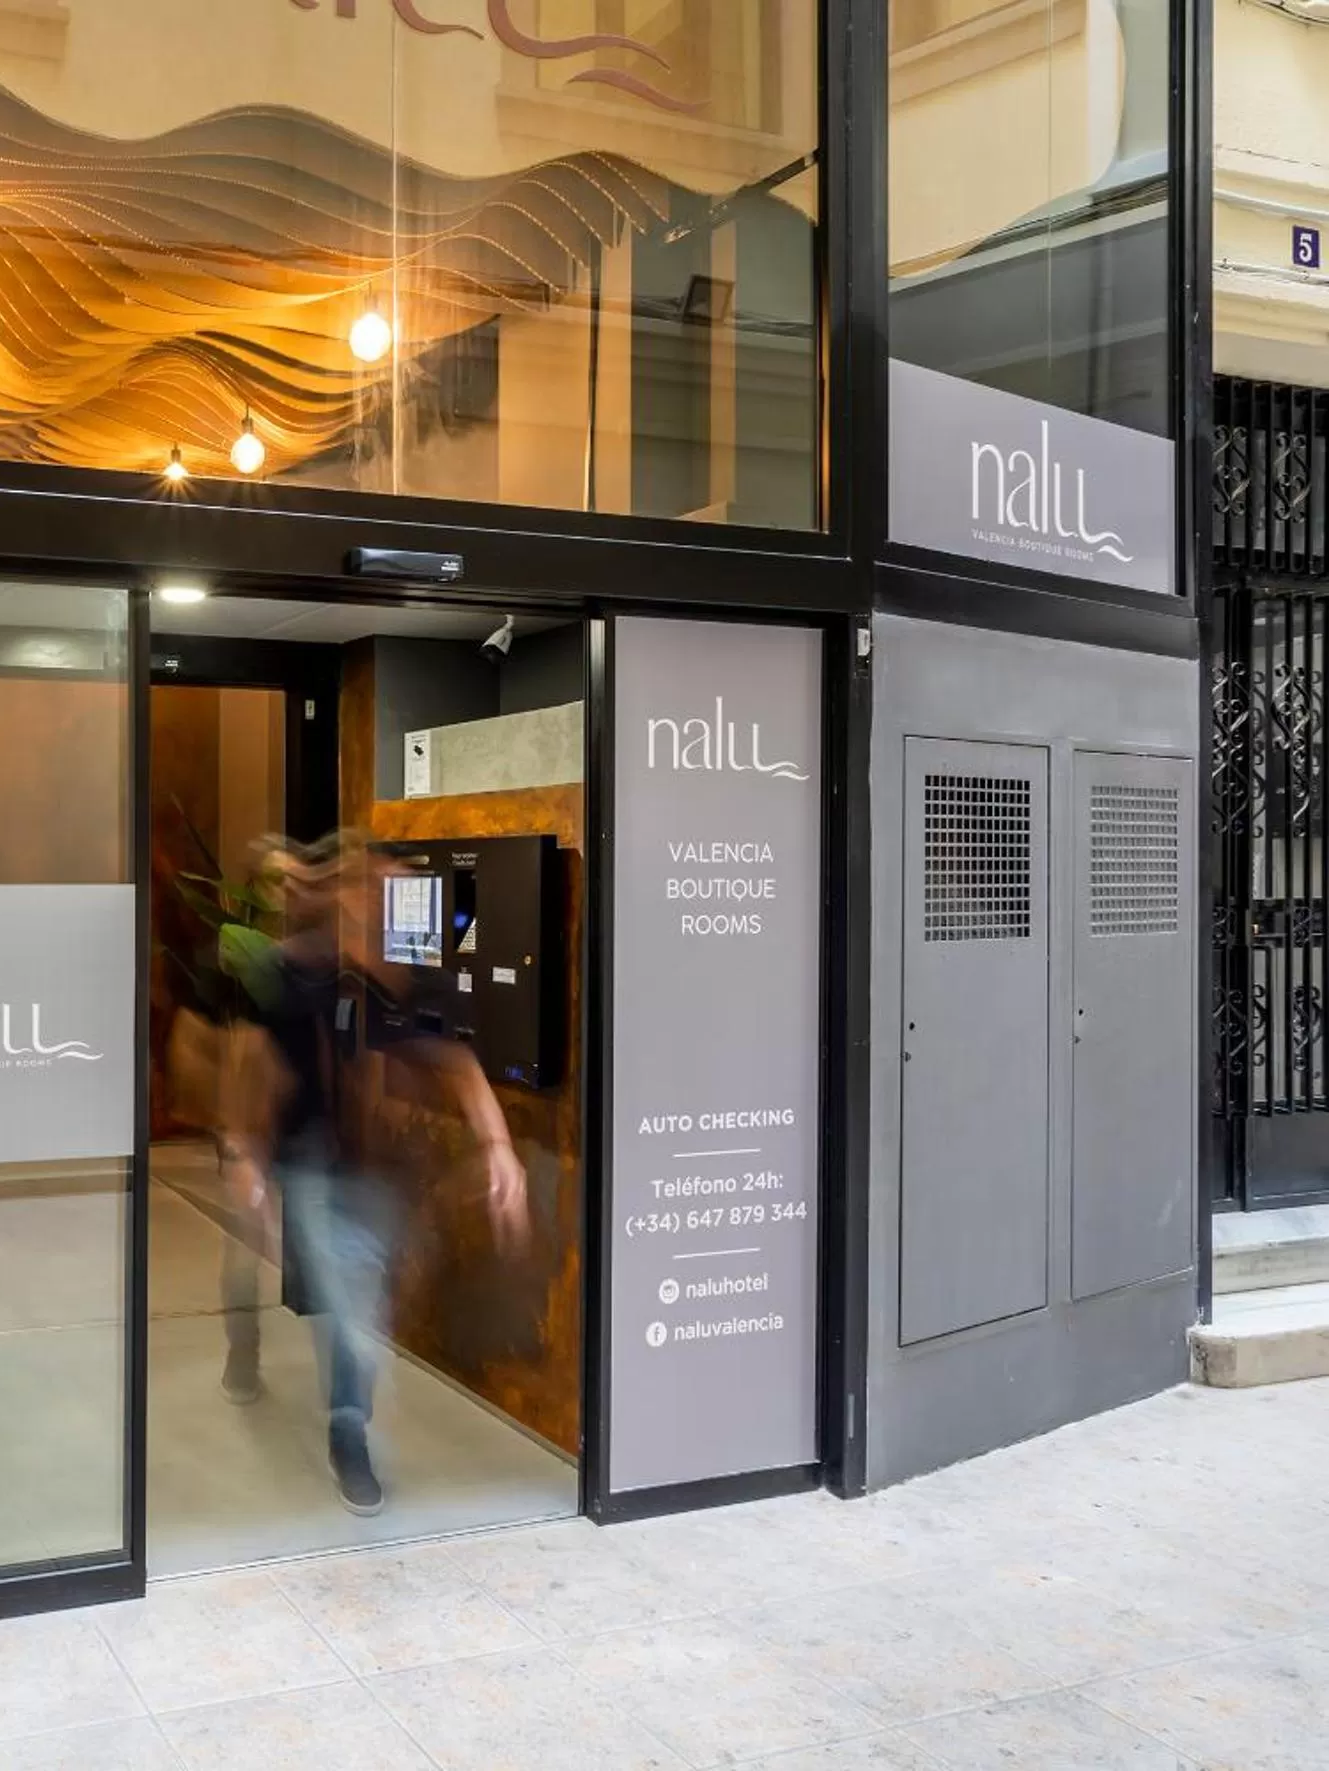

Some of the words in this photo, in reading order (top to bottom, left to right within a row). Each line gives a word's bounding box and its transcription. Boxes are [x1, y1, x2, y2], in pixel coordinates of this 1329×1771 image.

[1299, 233, 1312, 262] 5
[971, 420, 1125, 546] nalu
[648, 696, 800, 771] nalu
[668, 842, 774, 863] VALENCIA
[667, 878, 776, 901] BOUTIQUE
[681, 914, 762, 935] ROOMS
[638, 1115, 693, 1135] AUTO
[699, 1108, 795, 1131] CHECKING
[651, 1176, 737, 1199] Teléfono
[742, 1171, 784, 1192] 24h:
[625, 1212, 680, 1237] (+34)
[686, 1208, 724, 1229] 647
[729, 1204, 765, 1225] 879
[771, 1201, 807, 1222] 344
[686, 1272, 769, 1299] naluhotel
[674, 1312, 784, 1341] naluvalencia
